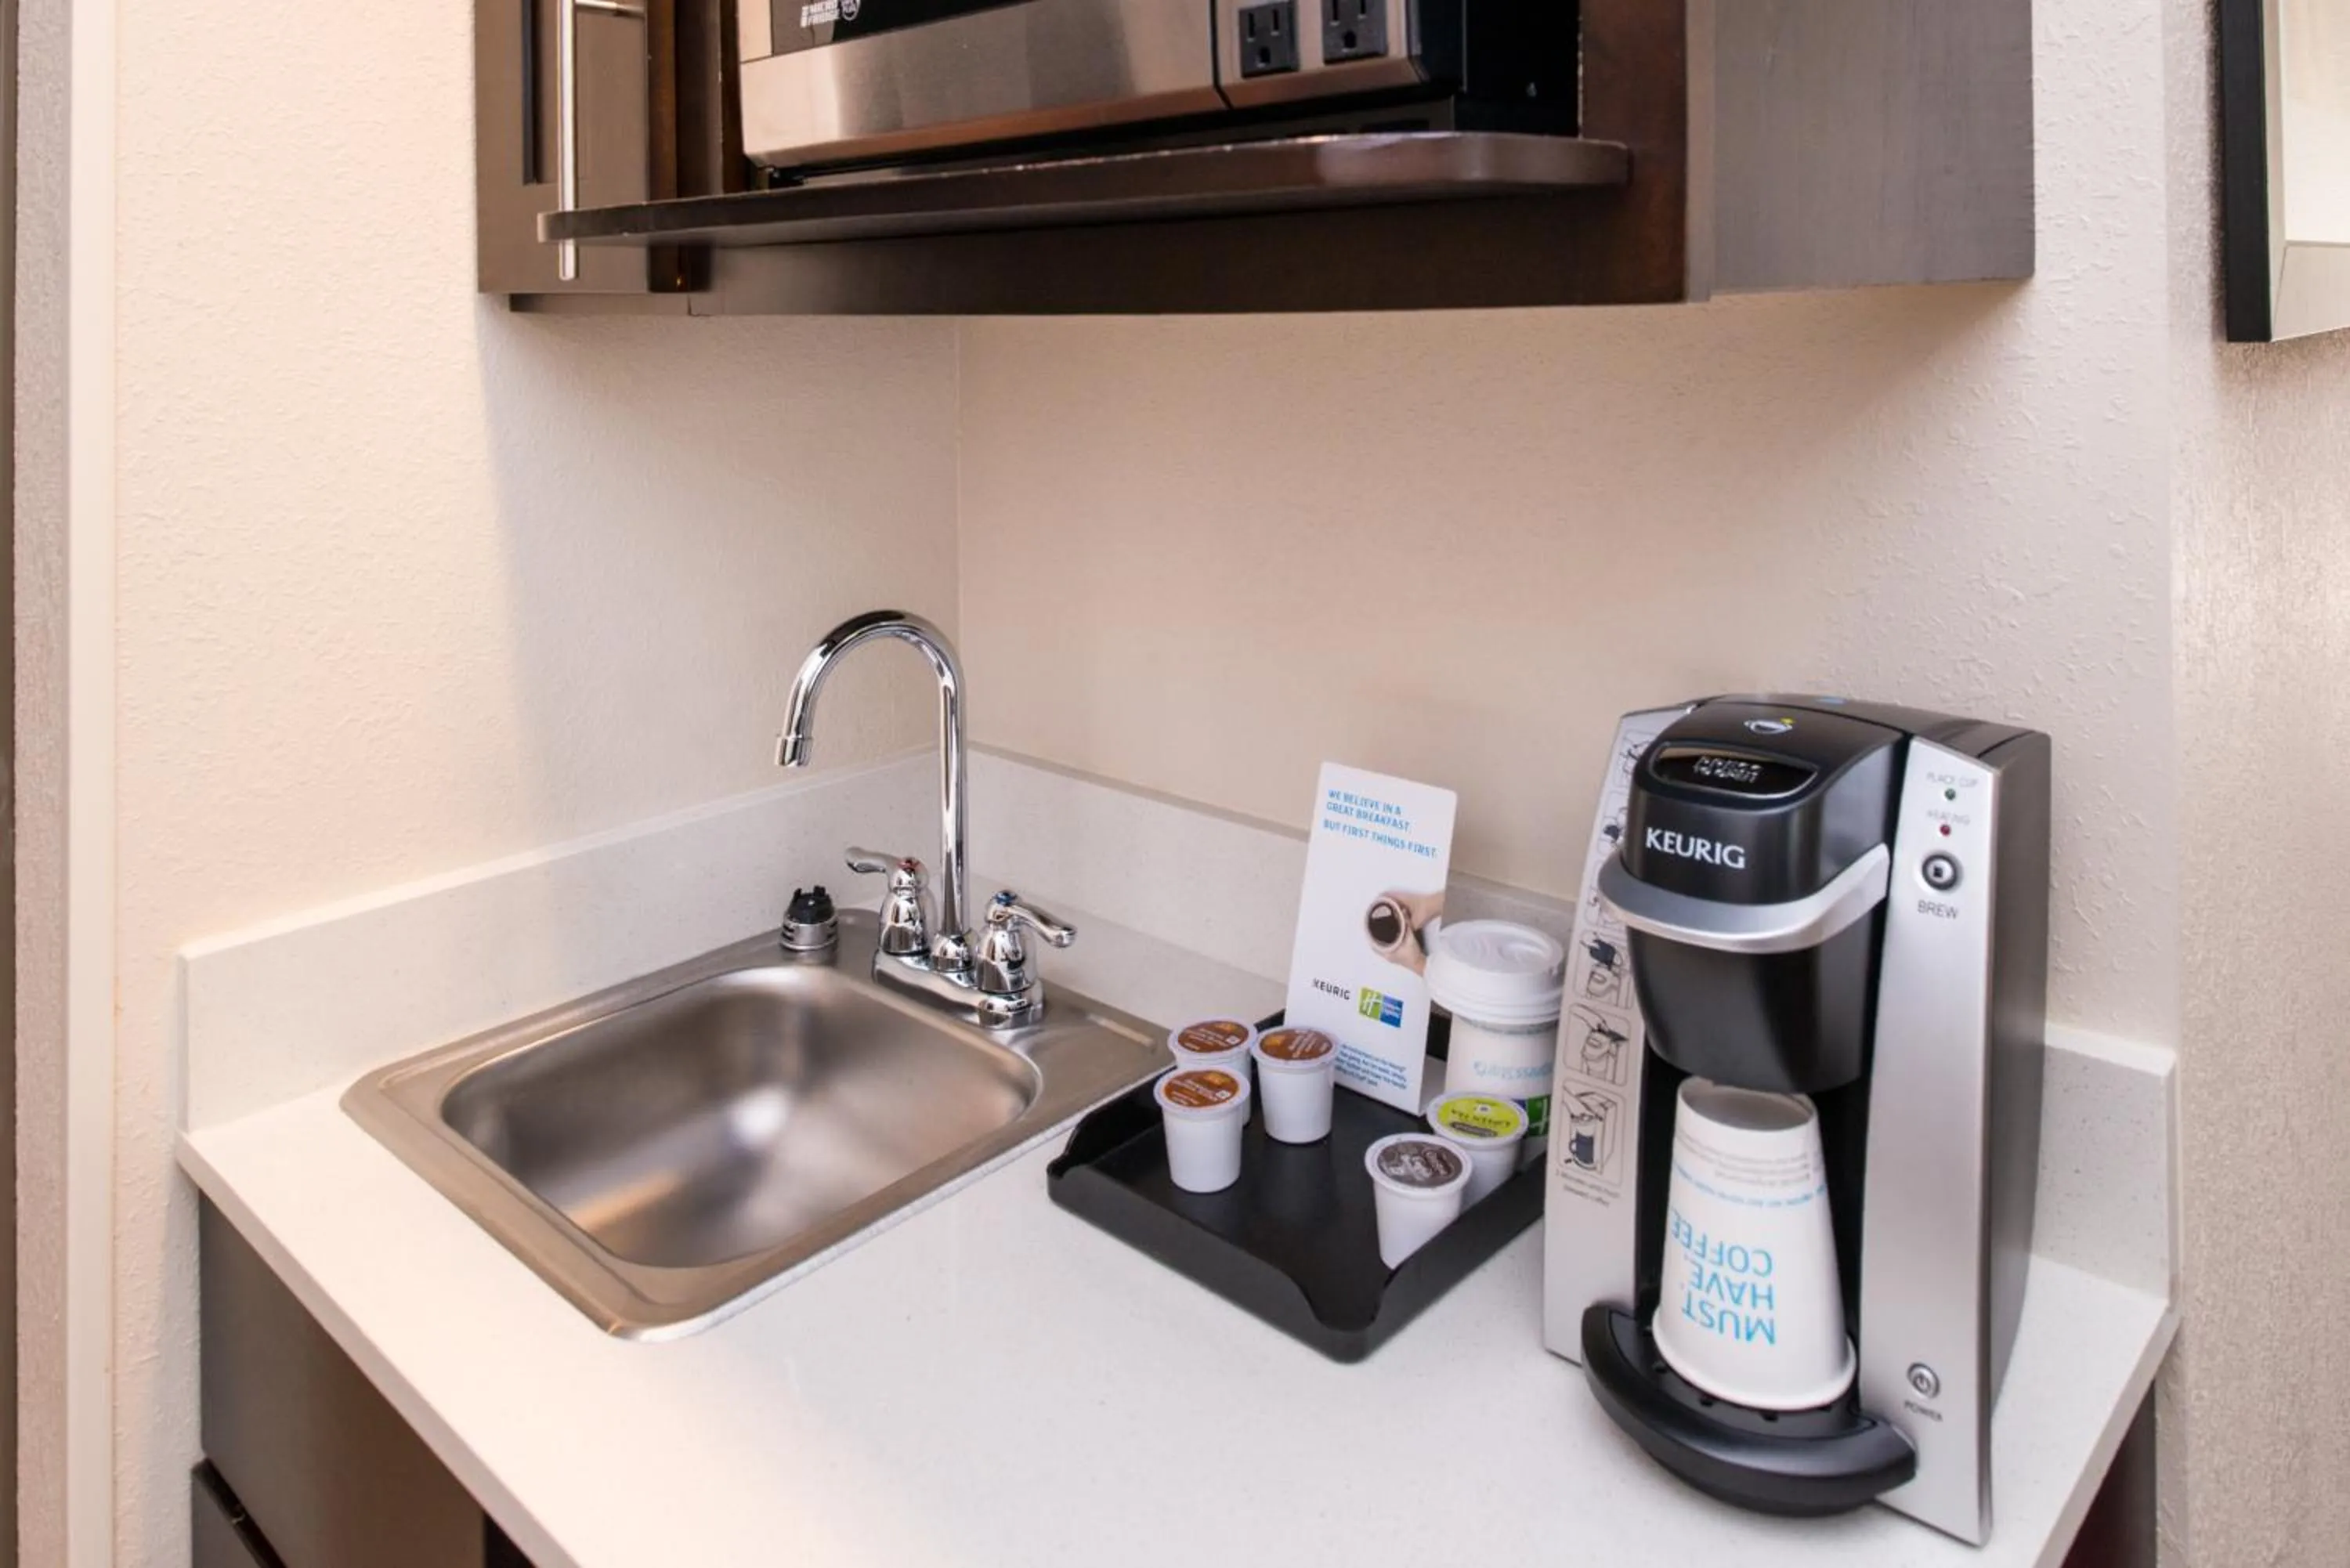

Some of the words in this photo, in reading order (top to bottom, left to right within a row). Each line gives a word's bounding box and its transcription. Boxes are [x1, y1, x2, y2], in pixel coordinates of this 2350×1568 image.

[1326, 801, 1354, 816] GREAT
[1328, 789, 1341, 800] WE
[1343, 793, 1379, 811] BELIEVE
[1383, 802, 1393, 814] IN
[1324, 818, 1341, 831] BUT
[1343, 824, 1370, 839] FIRST
[1372, 831, 1406, 850] THINGS
[1646, 826, 1746, 869] KEURIG
[1918, 899, 1958, 919] BREW
[1312, 977, 1351, 1001] KEURIG
[1904, 1400, 1943, 1422] POWER
